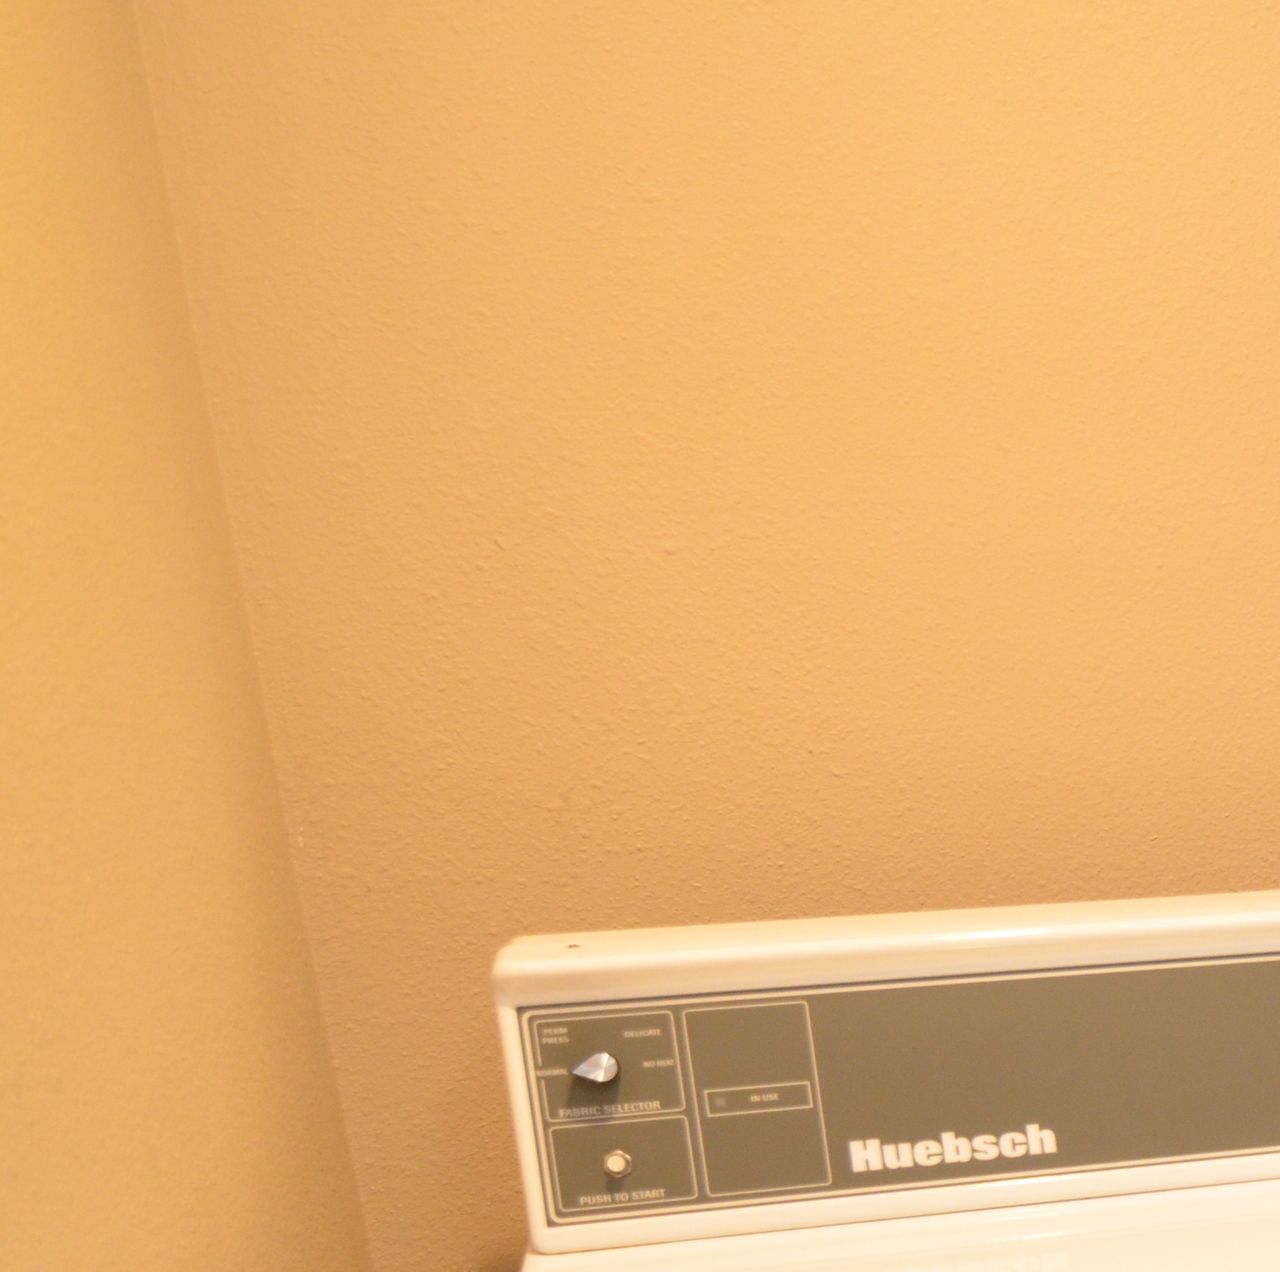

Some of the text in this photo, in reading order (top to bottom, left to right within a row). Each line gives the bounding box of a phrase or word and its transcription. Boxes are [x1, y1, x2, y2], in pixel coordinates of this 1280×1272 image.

[542, 1035, 569, 1044] PRESS
[623, 1028, 660, 1038] DELICATE
[762, 1093, 779, 1101] USE
[558, 1100, 661, 1118] FABRIC SELECTOR
[849, 1123, 1058, 1173] Huebsch
[580, 1188, 667, 1205] PUSH TO START
